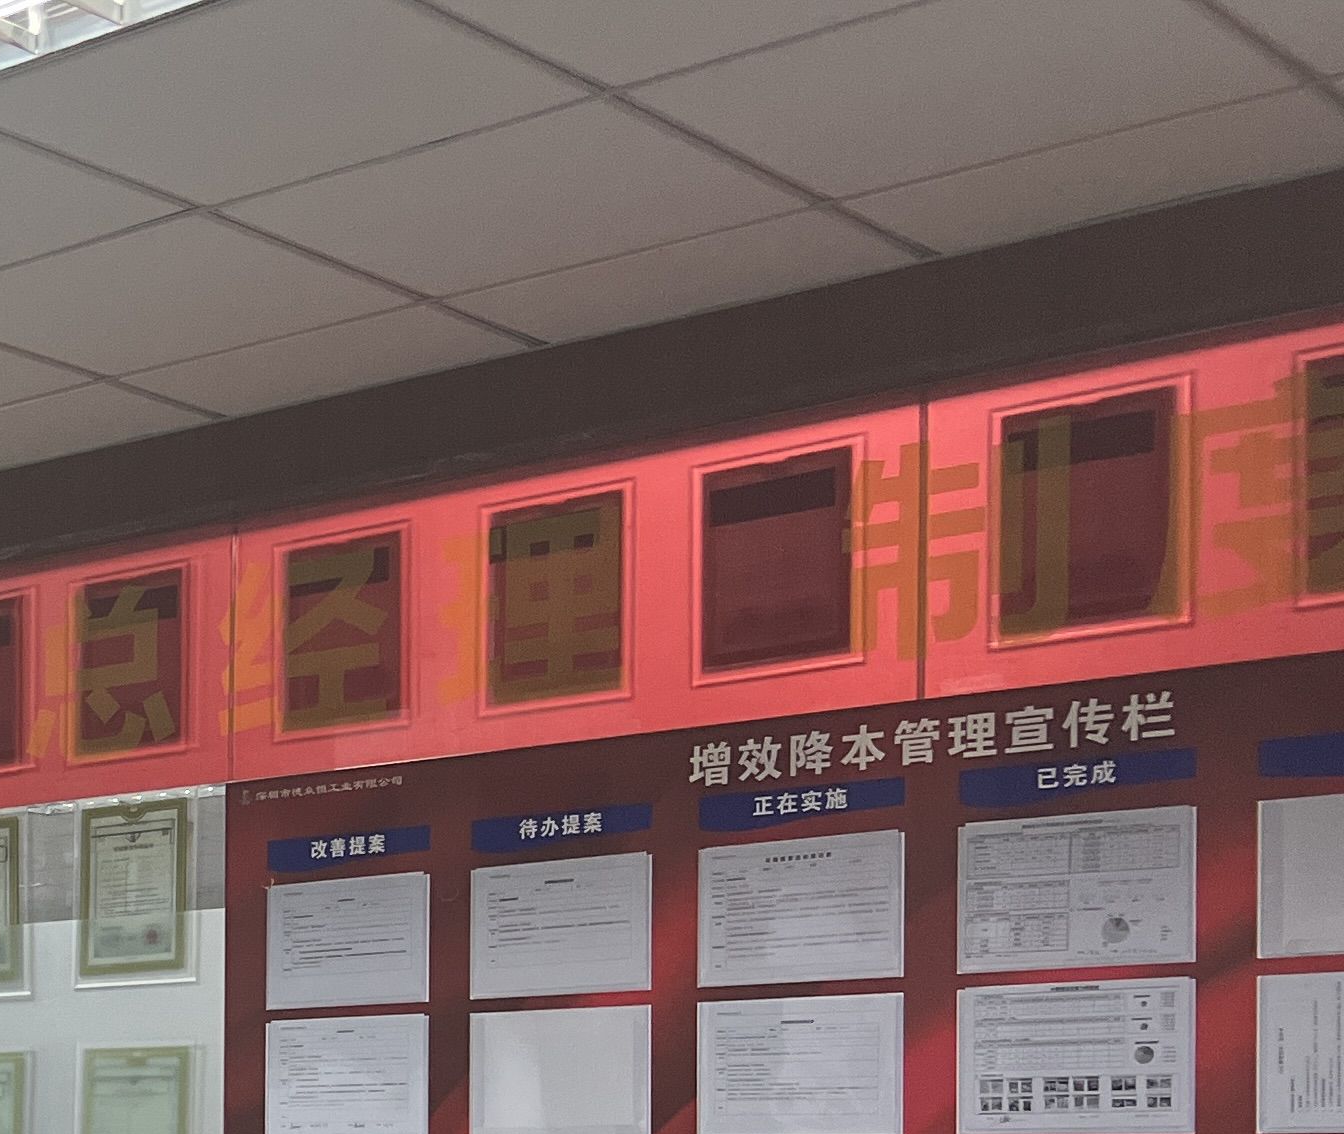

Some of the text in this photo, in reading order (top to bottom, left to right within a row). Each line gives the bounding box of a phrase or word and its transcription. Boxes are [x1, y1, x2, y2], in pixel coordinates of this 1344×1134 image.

[688, 691, 1176, 786] 增效降本管理宣传栏
[1037, 760, 1117, 789] 已完成
[753, 787, 849, 816] 正在实施
[518, 811, 603, 840] 待办提案
[311, 834, 386, 859] 改善提案
